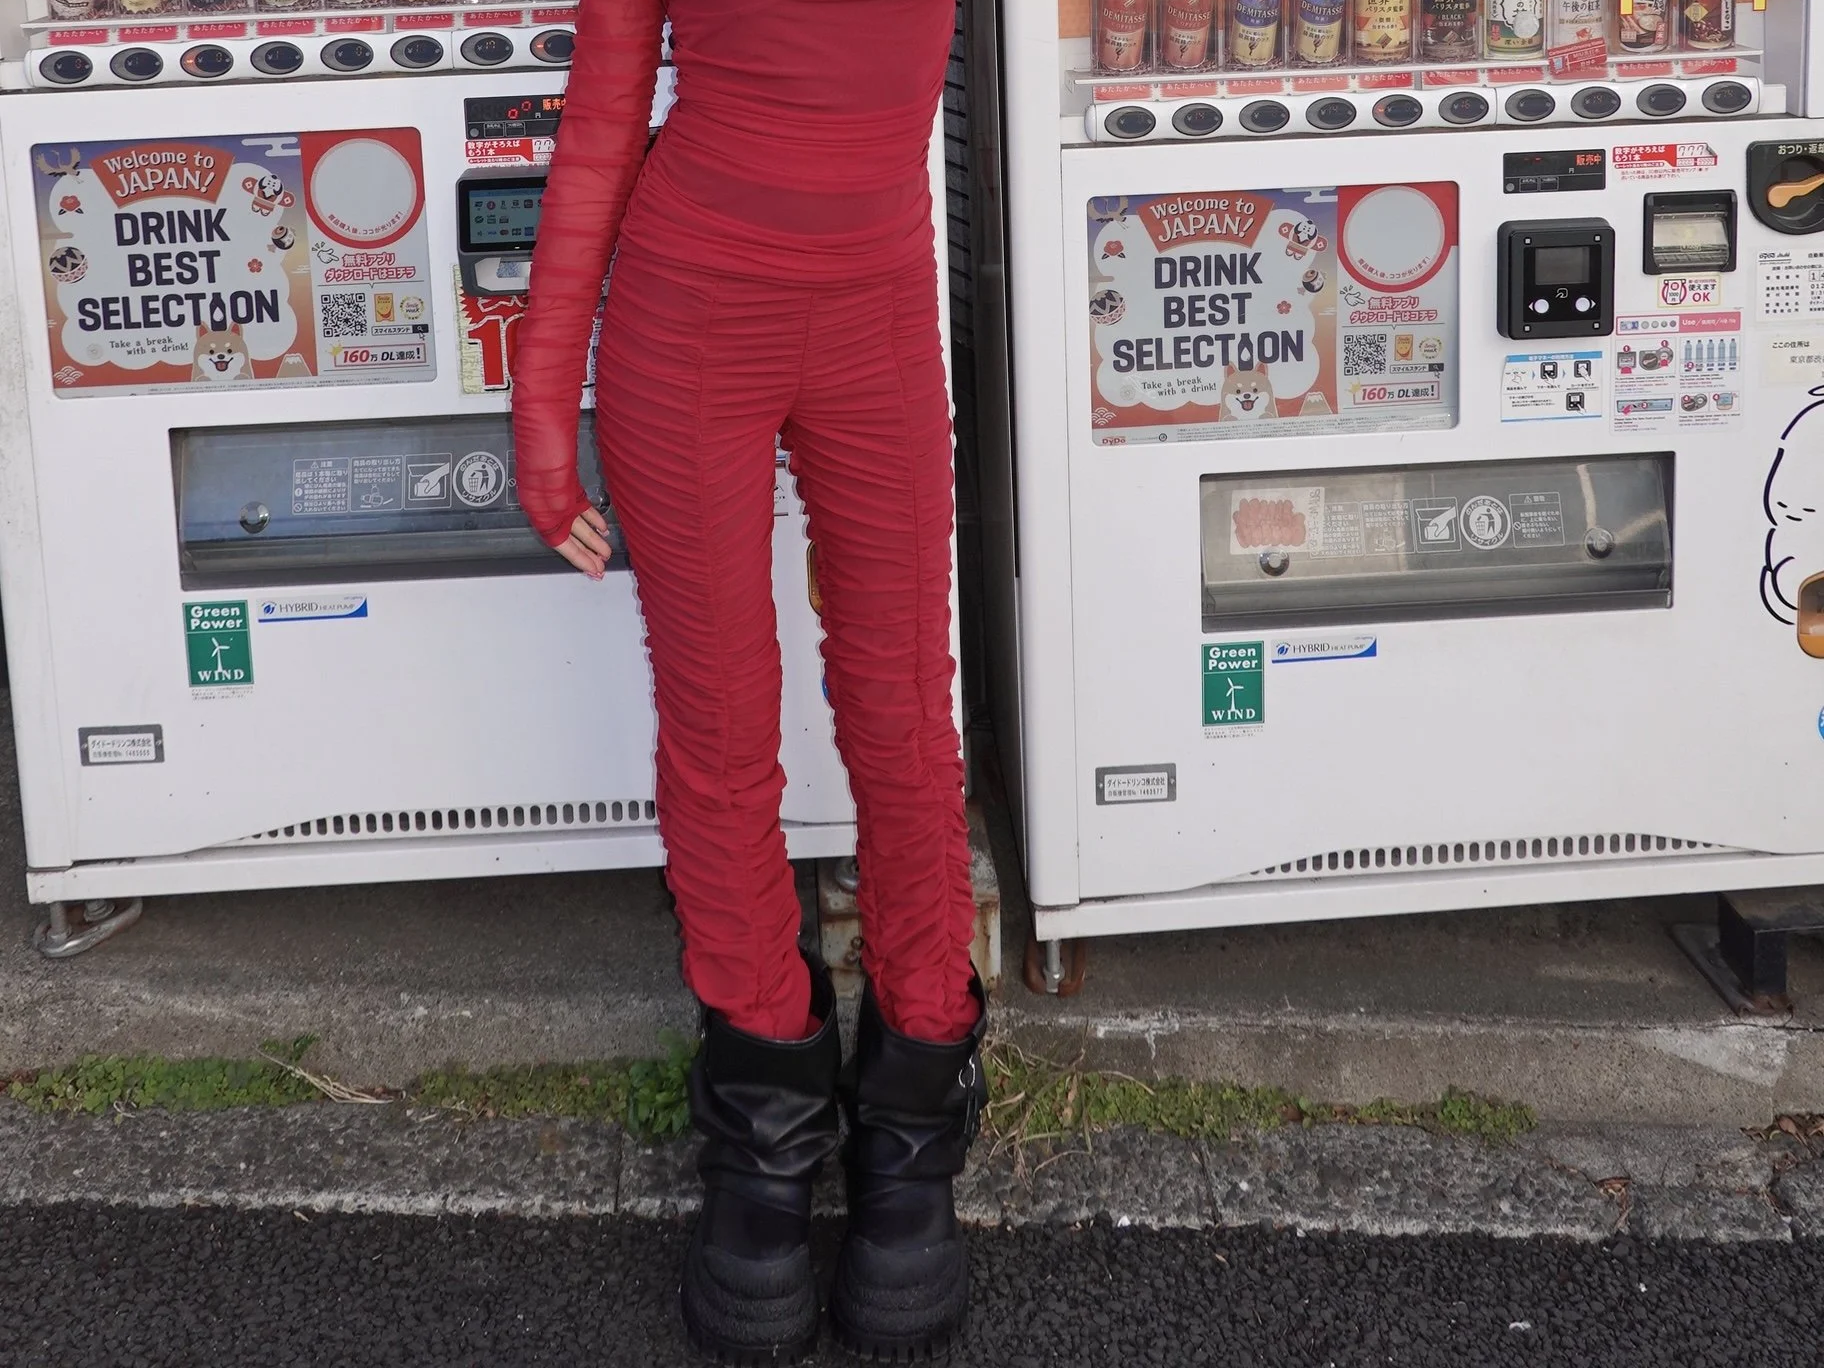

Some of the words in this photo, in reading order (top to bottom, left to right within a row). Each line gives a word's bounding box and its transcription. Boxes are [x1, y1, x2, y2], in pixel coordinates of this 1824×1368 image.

[1237, 3, 1278, 17] DEMITASSE
[1301, 0, 1344, 16] DEMITASSE
[1562, 0, 1600, 13] 午後の紅茶
[1103, 8, 1146, 23] DEMITASSE
[1167, 6, 1211, 21] DEMITASSE
[468, 148, 495, 156] もう1本
[1614, 145, 1665, 154] 数字がそろえば
[104, 150, 187, 174] Welcome
[194, 152, 215, 169] to
[1576, 154, 1602, 166] 販売中
[116, 169, 216, 198] JAPAN!
[1150, 197, 1229, 220] Welcome
[1236, 199, 1255, 215] to
[114, 208, 231, 246] DRINK
[1158, 215, 1255, 242] JAPAN!
[342, 253, 396, 268] 無料アプリ
[127, 250, 221, 287] BEST
[325, 266, 416, 282] ダウンロードはコチラ
[1154, 252, 1263, 289] DRINK
[1688, 284, 1716, 292] 使えます
[1368, 296, 1420, 310] 無料アプリ
[1692, 292, 1711, 303] OK
[1163, 292, 1252, 329] BEST
[1350, 309, 1438, 324] ダウンロードはコチラ
[109, 340, 132, 349] Take
[146, 336, 173, 346] break
[1772, 340, 1810, 349] ここの住所は
[126, 346, 147, 356] with
[162, 343, 189, 352] drink!
[1141, 381, 1163, 390] Take
[1176, 377, 1202, 386] break
[1157, 388, 1177, 397] with
[1191, 383, 1217, 393] drink!
[1102, 436, 1126, 447] DyDo
[190, 606, 241, 617] Green
[279, 602, 318, 613] HYBRID
[190, 618, 243, 631] Power
[1209, 647, 1256, 658] Green
[1293, 642, 1330, 653] HYBRID
[1208, 659, 1258, 670] Power
[198, 668, 245, 682] WIND
[1212, 708, 1256, 720] WIND
